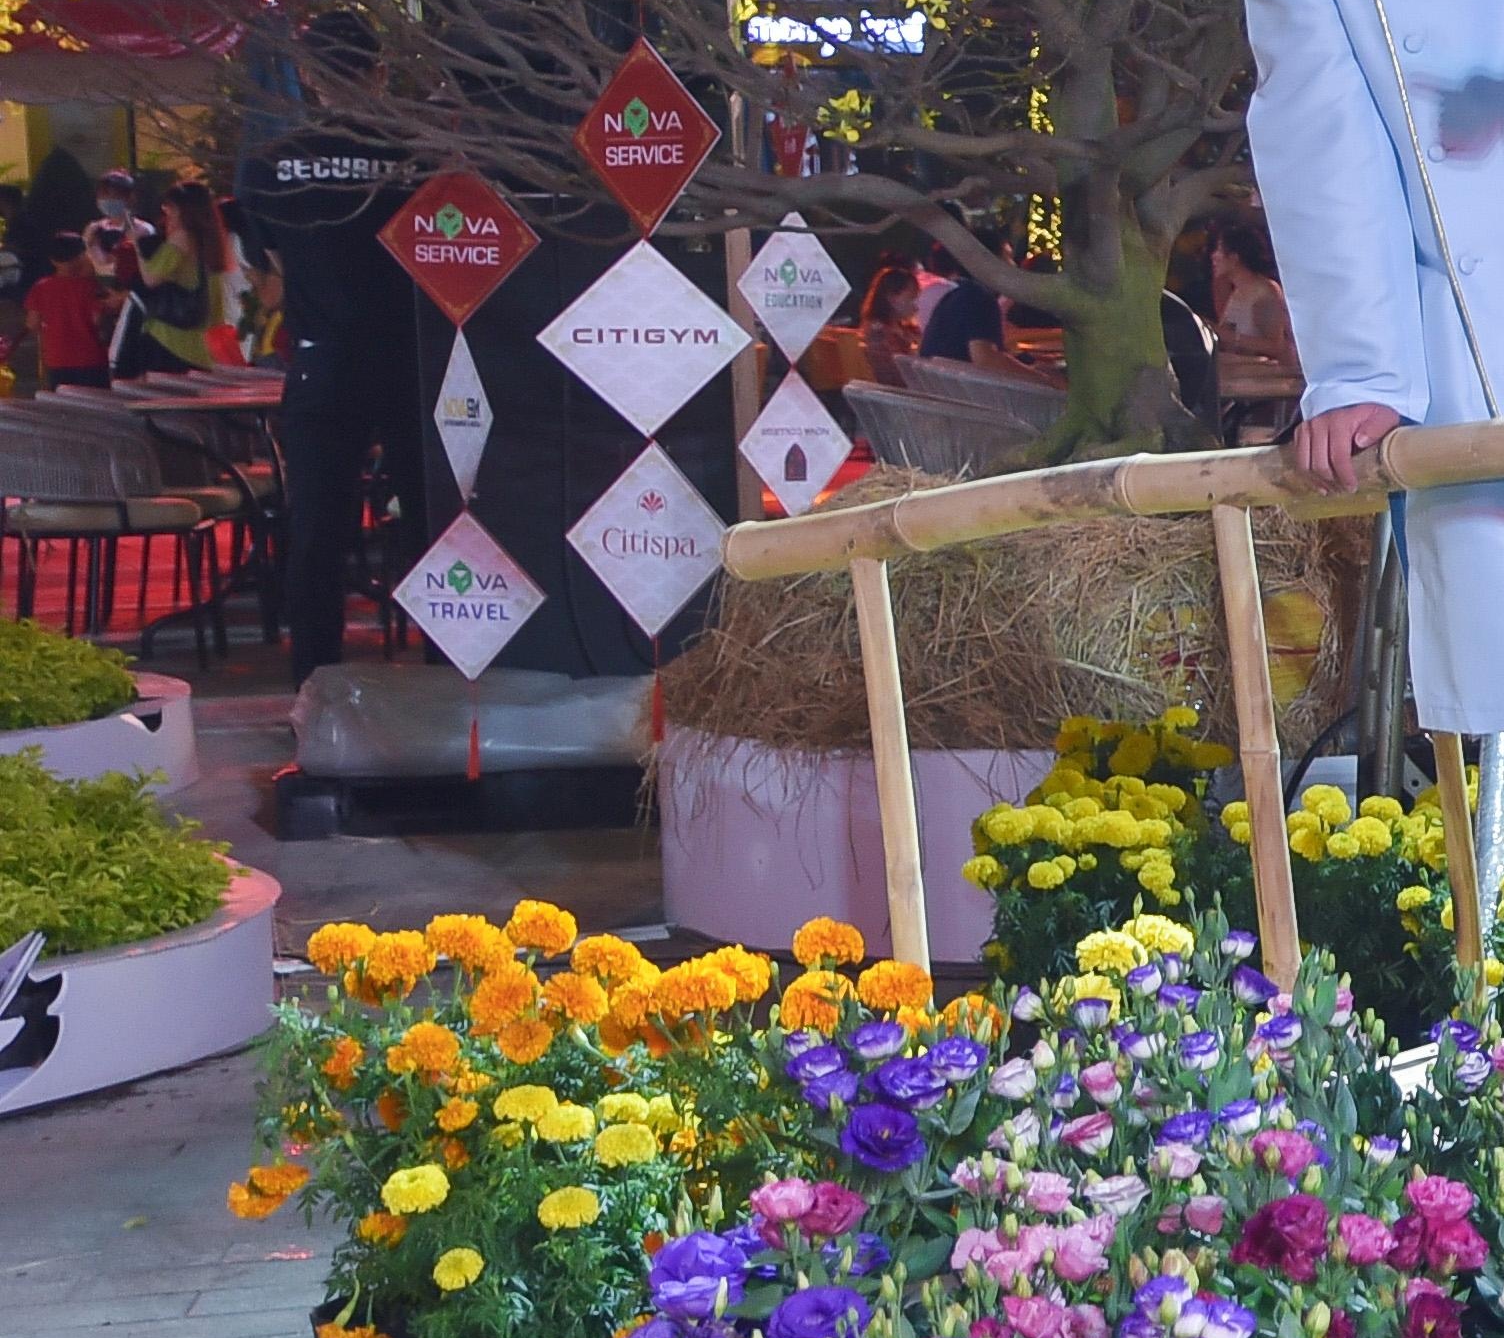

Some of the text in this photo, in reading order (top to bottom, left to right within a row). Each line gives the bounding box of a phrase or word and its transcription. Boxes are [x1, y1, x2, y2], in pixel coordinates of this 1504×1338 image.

[605, 145, 684, 165] SERVICE
[415, 245, 500, 265] SERVICE
[764, 293, 823, 309] EDUCATION
[572, 327, 719, 345] CITIGYM
[602, 527, 701, 560] Citispa
[429, 601, 510, 621] TRAVEL
